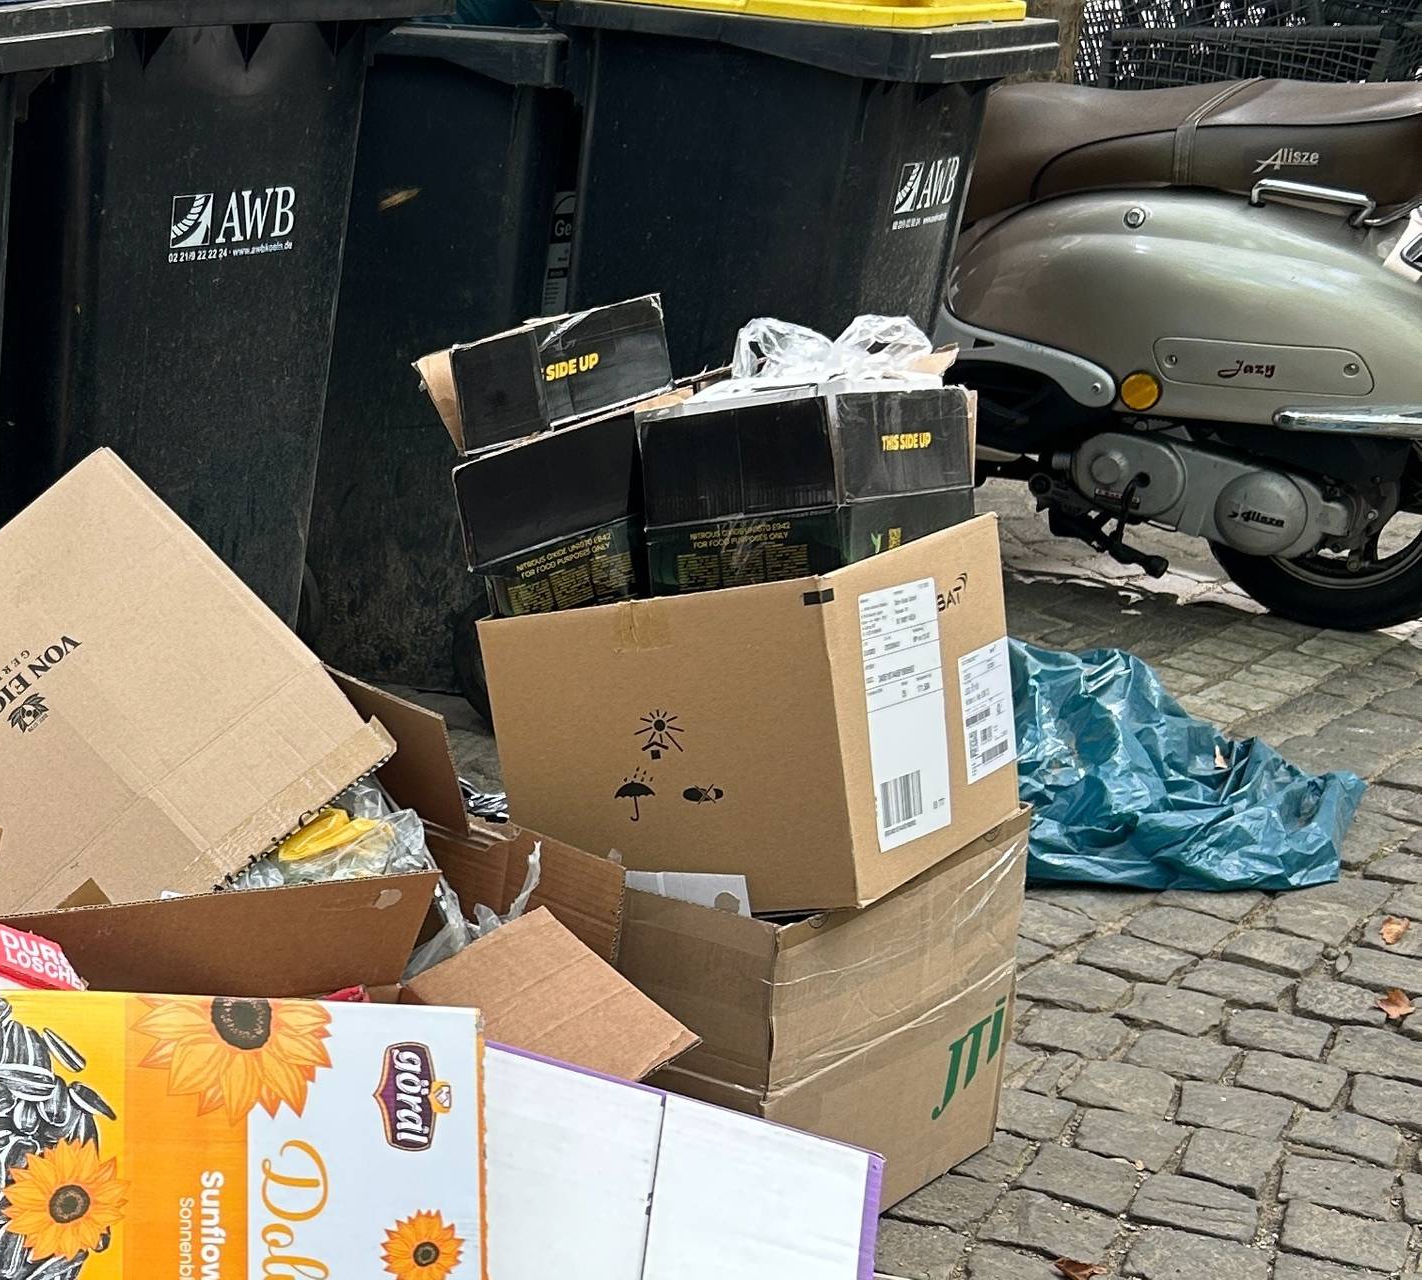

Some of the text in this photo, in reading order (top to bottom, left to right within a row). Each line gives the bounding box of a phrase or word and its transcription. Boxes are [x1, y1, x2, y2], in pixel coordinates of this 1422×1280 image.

[1252, 148, 1319, 173] Alisze
[916, 156, 959, 209] AWB
[215, 186, 295, 243] AWB
[546, 358, 577, 382] SIDE
[579, 352, 599, 372] UP
[1217, 360, 1275, 378] Jazy
[881, 432, 932, 451] THIS SIDE UP
[693, 540, 708, 549] FOR
[709, 538, 730, 547] FOOD
[521, 542, 611, 580] FOR FOOD PURPOSES ONLY
[937, 585, 962, 612] BAT
[28, 635, 82, 680] VON
